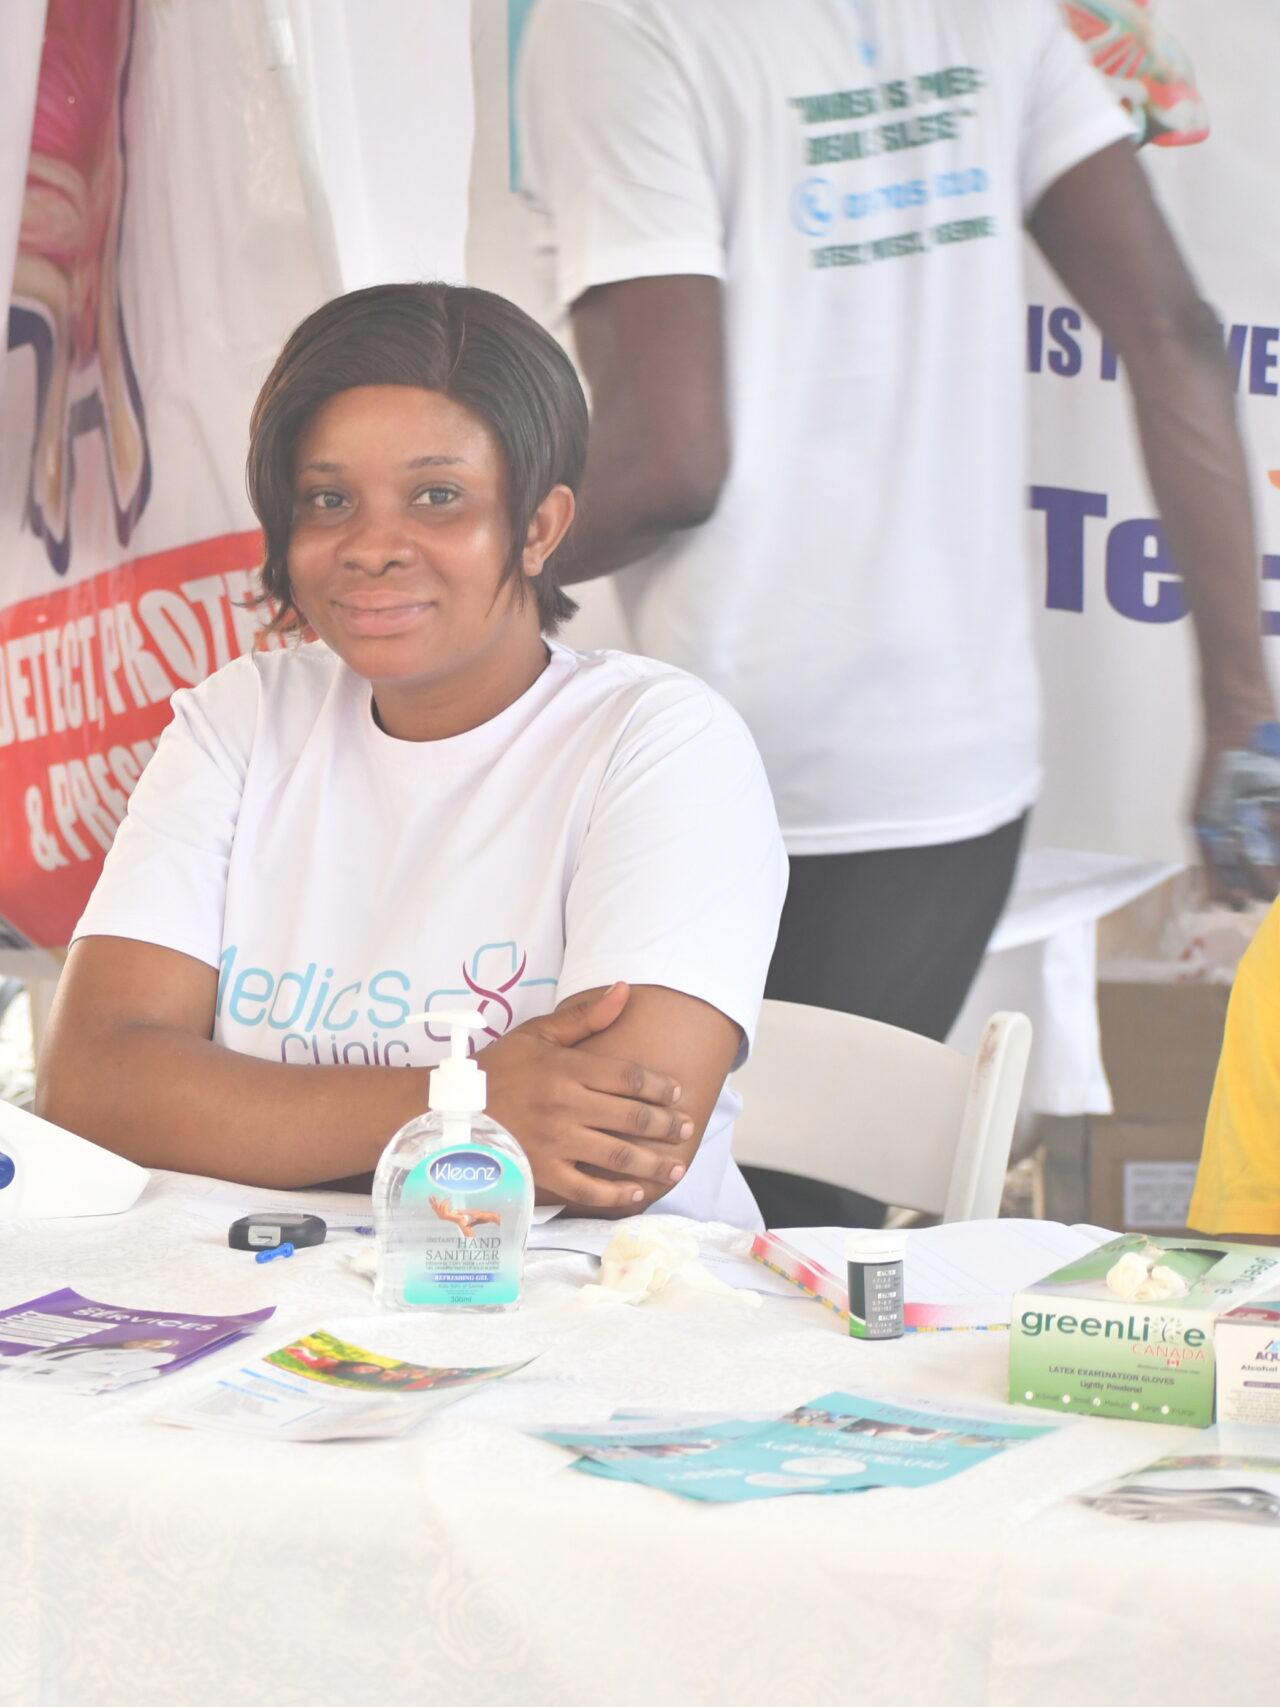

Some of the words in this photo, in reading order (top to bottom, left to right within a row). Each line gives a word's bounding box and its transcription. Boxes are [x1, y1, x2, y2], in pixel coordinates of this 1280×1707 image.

[1027, 304, 1083, 378] IS
[1031, 484, 1194, 625] Te
[25, 785, 69, 872] &
[49, 737, 161, 862] PRES
[434, 1163, 497, 1182] Kleanz
[457, 1236, 502, 1249] HAND
[425, 1249, 500, 1261] SANITIZER
[73, 1308, 218, 1332] SERVICES
[1132, 1342, 1206, 1361] CANADA
[1048, 1365, 1074, 1375] LATEX
[1077, 1369, 1139, 1382] EXAMINATION
[1141, 1375, 1175, 1385] GLOVES
[1080, 1380, 1104, 1390] Lightly
